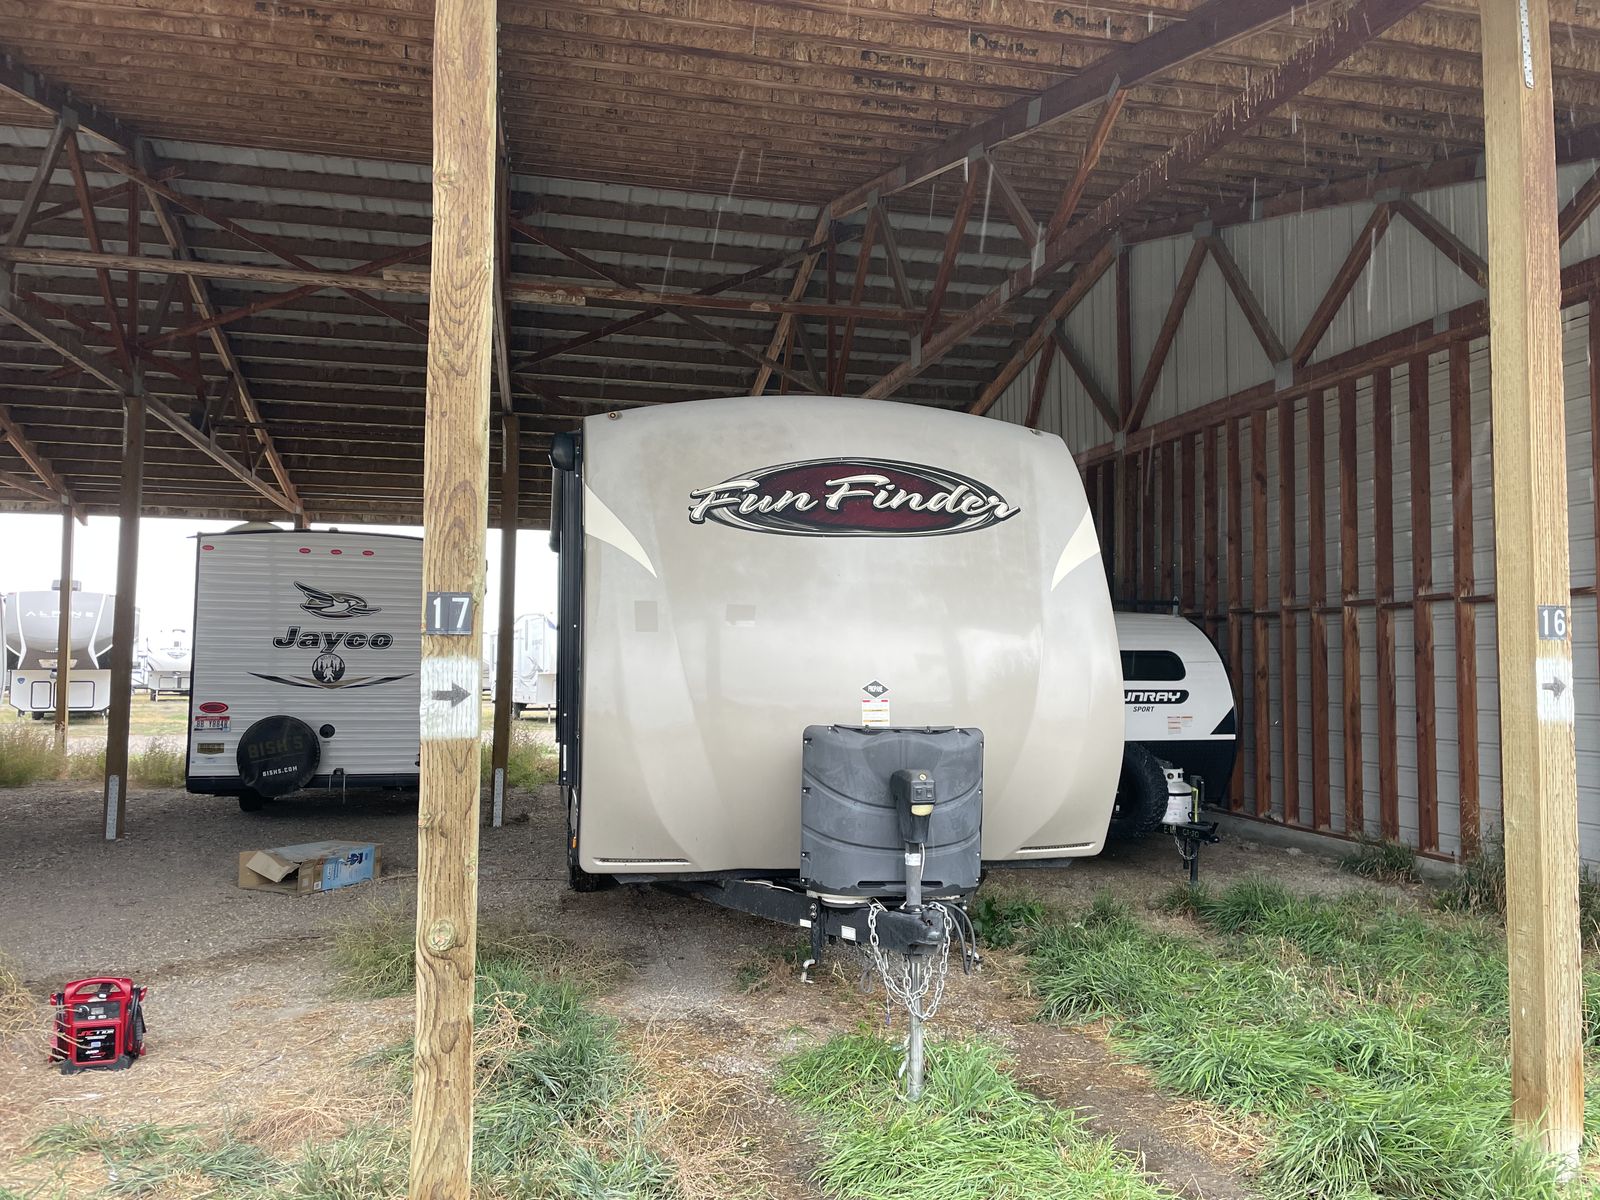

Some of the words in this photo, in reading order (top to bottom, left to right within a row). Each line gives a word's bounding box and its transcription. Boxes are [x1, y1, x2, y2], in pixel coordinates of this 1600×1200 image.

[688, 478, 819, 524] Fun
[825, 473, 1021, 522] Finder
[25, 609, 95, 619] ALPNE
[433, 597, 470, 629] 17
[1542, 609, 1566, 636] 16
[272, 625, 393, 654] Jayco
[1125, 691, 1181, 702] UNRAY
[1133, 705, 1155, 713] SPORT
[262, 765, 298, 777] BISHS.COM
